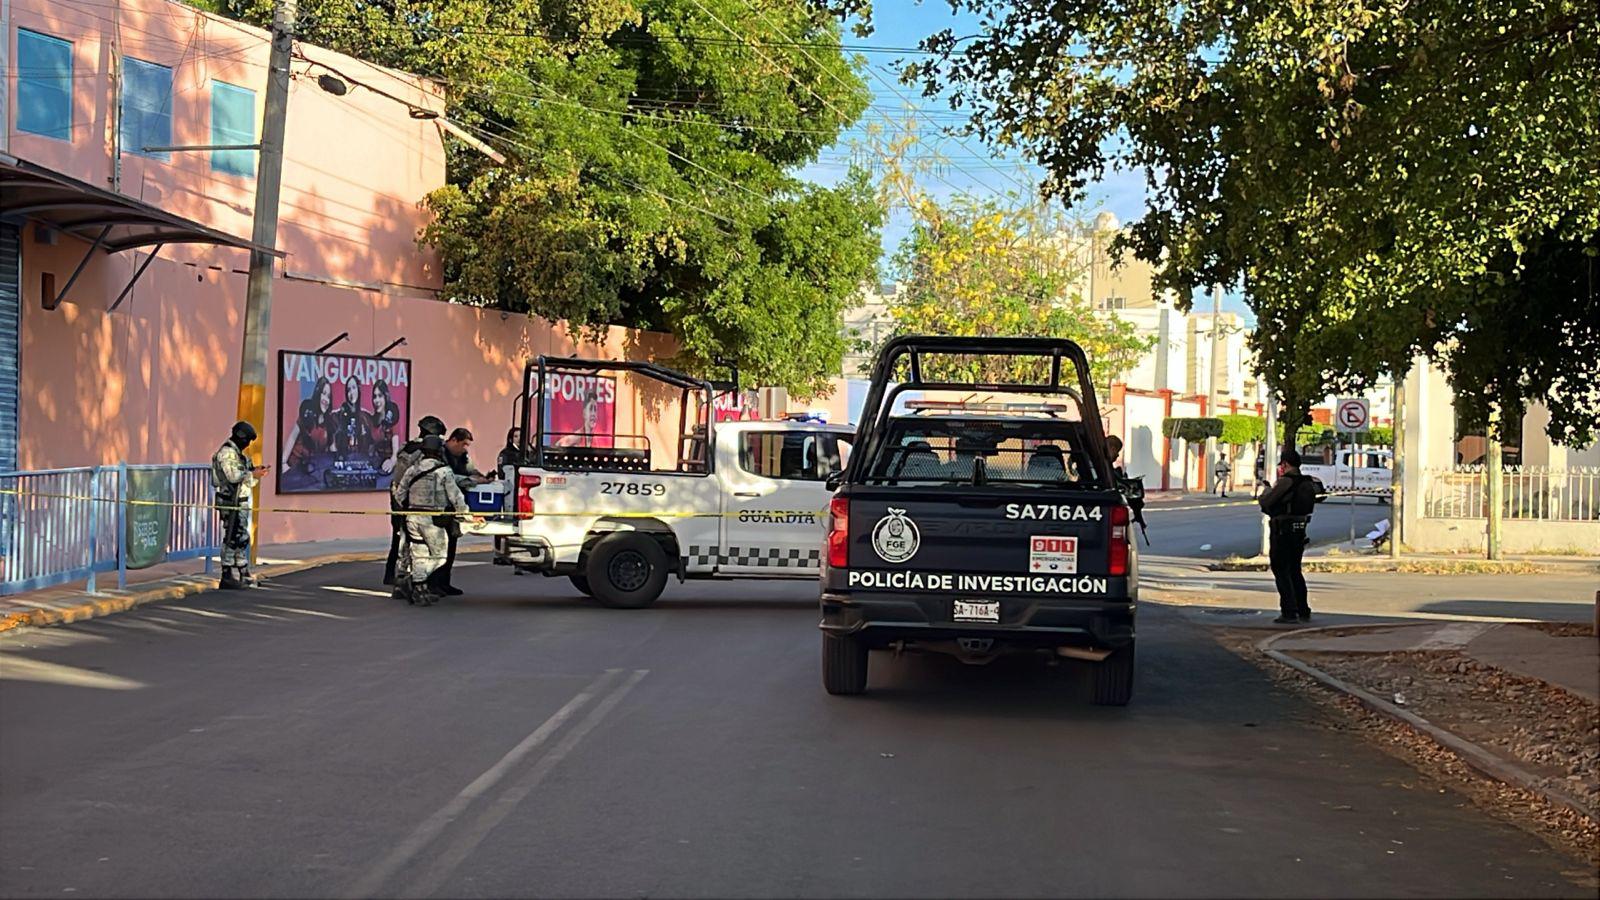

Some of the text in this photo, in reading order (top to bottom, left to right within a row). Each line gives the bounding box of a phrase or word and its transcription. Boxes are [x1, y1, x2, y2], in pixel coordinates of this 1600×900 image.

[283, 354, 409, 387] VANGUARDIA
[600, 482, 666, 496] 27859
[738, 509, 816, 525] GUARDIA
[1006, 503, 1103, 521] SA716A4
[886, 540, 906, 549] FGE
[1035, 540, 1074, 553] 911
[848, 570, 1107, 594] POLICÍA DE INVESTIGACIÓN
